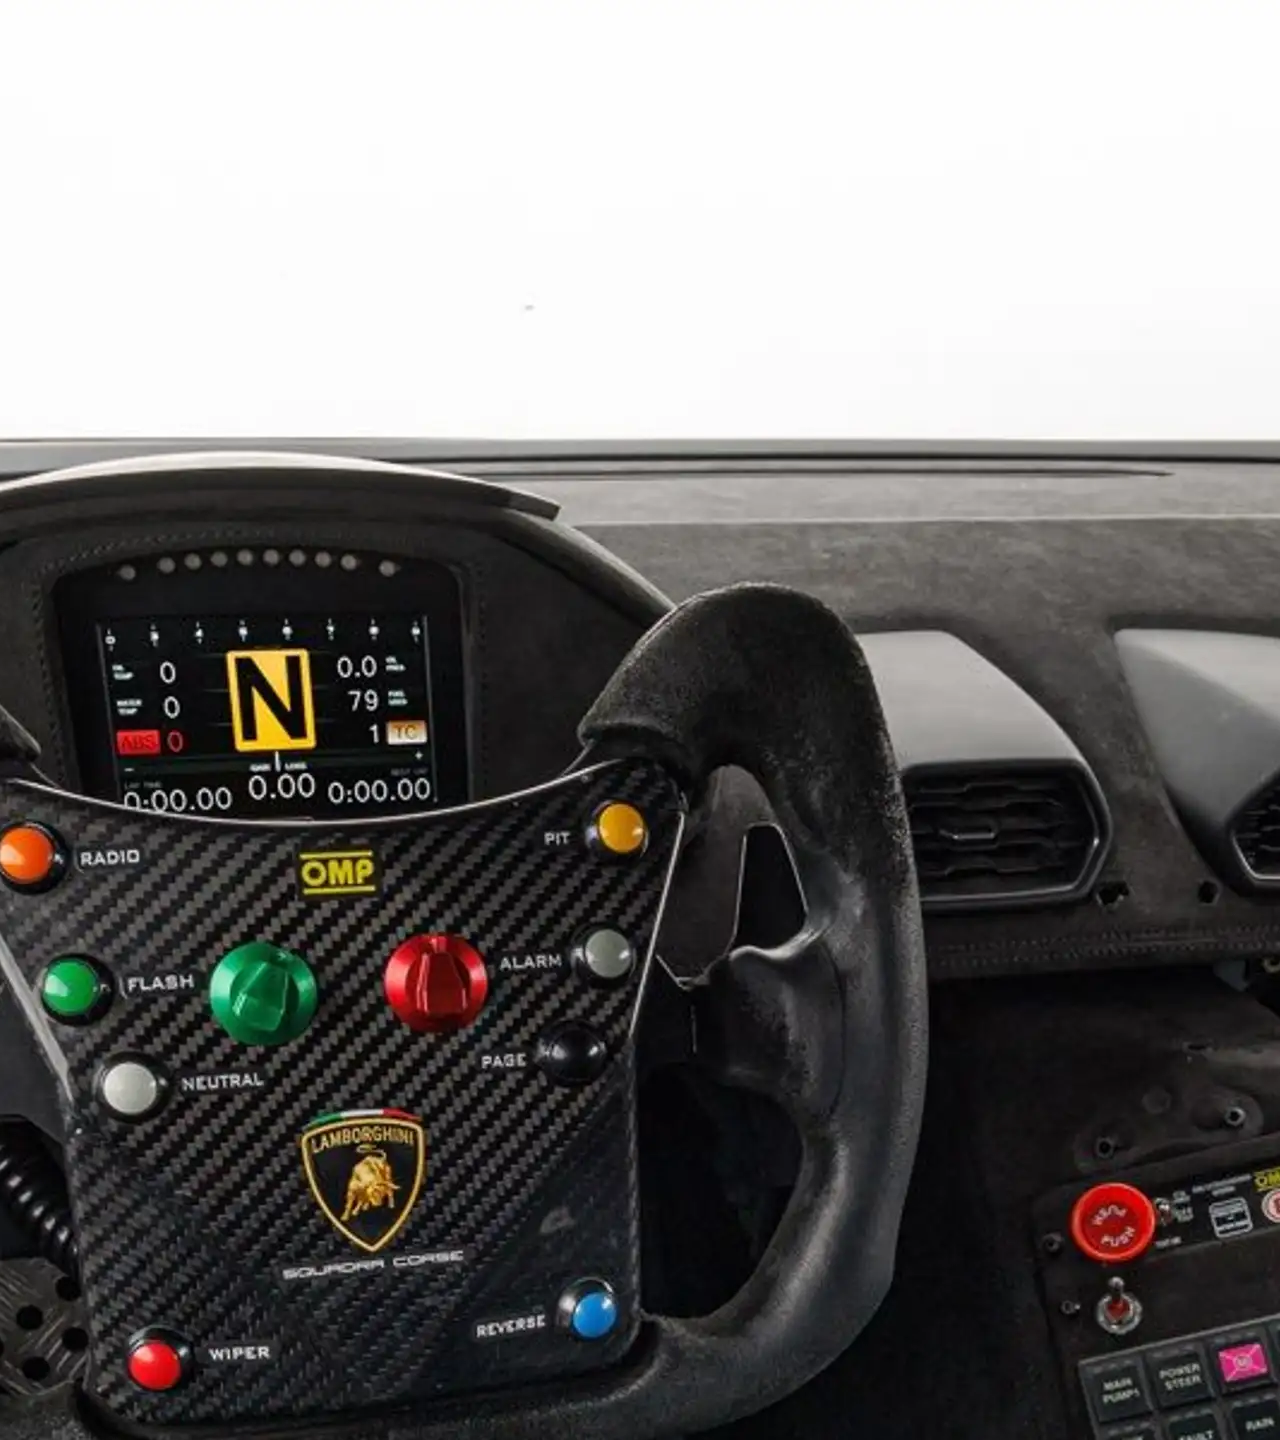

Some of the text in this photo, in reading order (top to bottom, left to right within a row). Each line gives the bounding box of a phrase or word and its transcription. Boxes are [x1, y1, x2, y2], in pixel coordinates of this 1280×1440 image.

[160, 661, 176, 684] 0
[337, 655, 378, 678] 0.0
[164, 696, 181, 719] 0
[234, 656, 308, 741] N
[347, 688, 379, 712] 79
[121, 733, 157, 750] ABS
[166, 730, 183, 753] 0
[369, 723, 380, 744] 1
[392, 723, 419, 741] TC
[248, 772, 316, 801] 0.00
[327, 776, 432, 805] 0:00.00
[124, 786, 233, 812] 0:00.00
[545, 832, 571, 847] PIT
[79, 848, 141, 867] RADIO
[301, 859, 375, 886] OMP
[500, 953, 563, 971] ALARM
[127, 974, 195, 993] FLASH
[481, 1053, 527, 1069] PAGE
[182, 1072, 265, 1092] NEUTRAL
[310, 1126, 416, 1153] LAMBORGHINI
[282, 1250, 465, 1281] SQUADRA CORSE
[476, 1314, 546, 1338] REVERSE
[209, 1344, 271, 1362] WIPER
[1158, 1362, 1202, 1379] POWER
[1102, 1376, 1133, 1392] MAIN
[1163, 1374, 1202, 1392] STEER
[1245, 1416, 1276, 1433] RAIN
